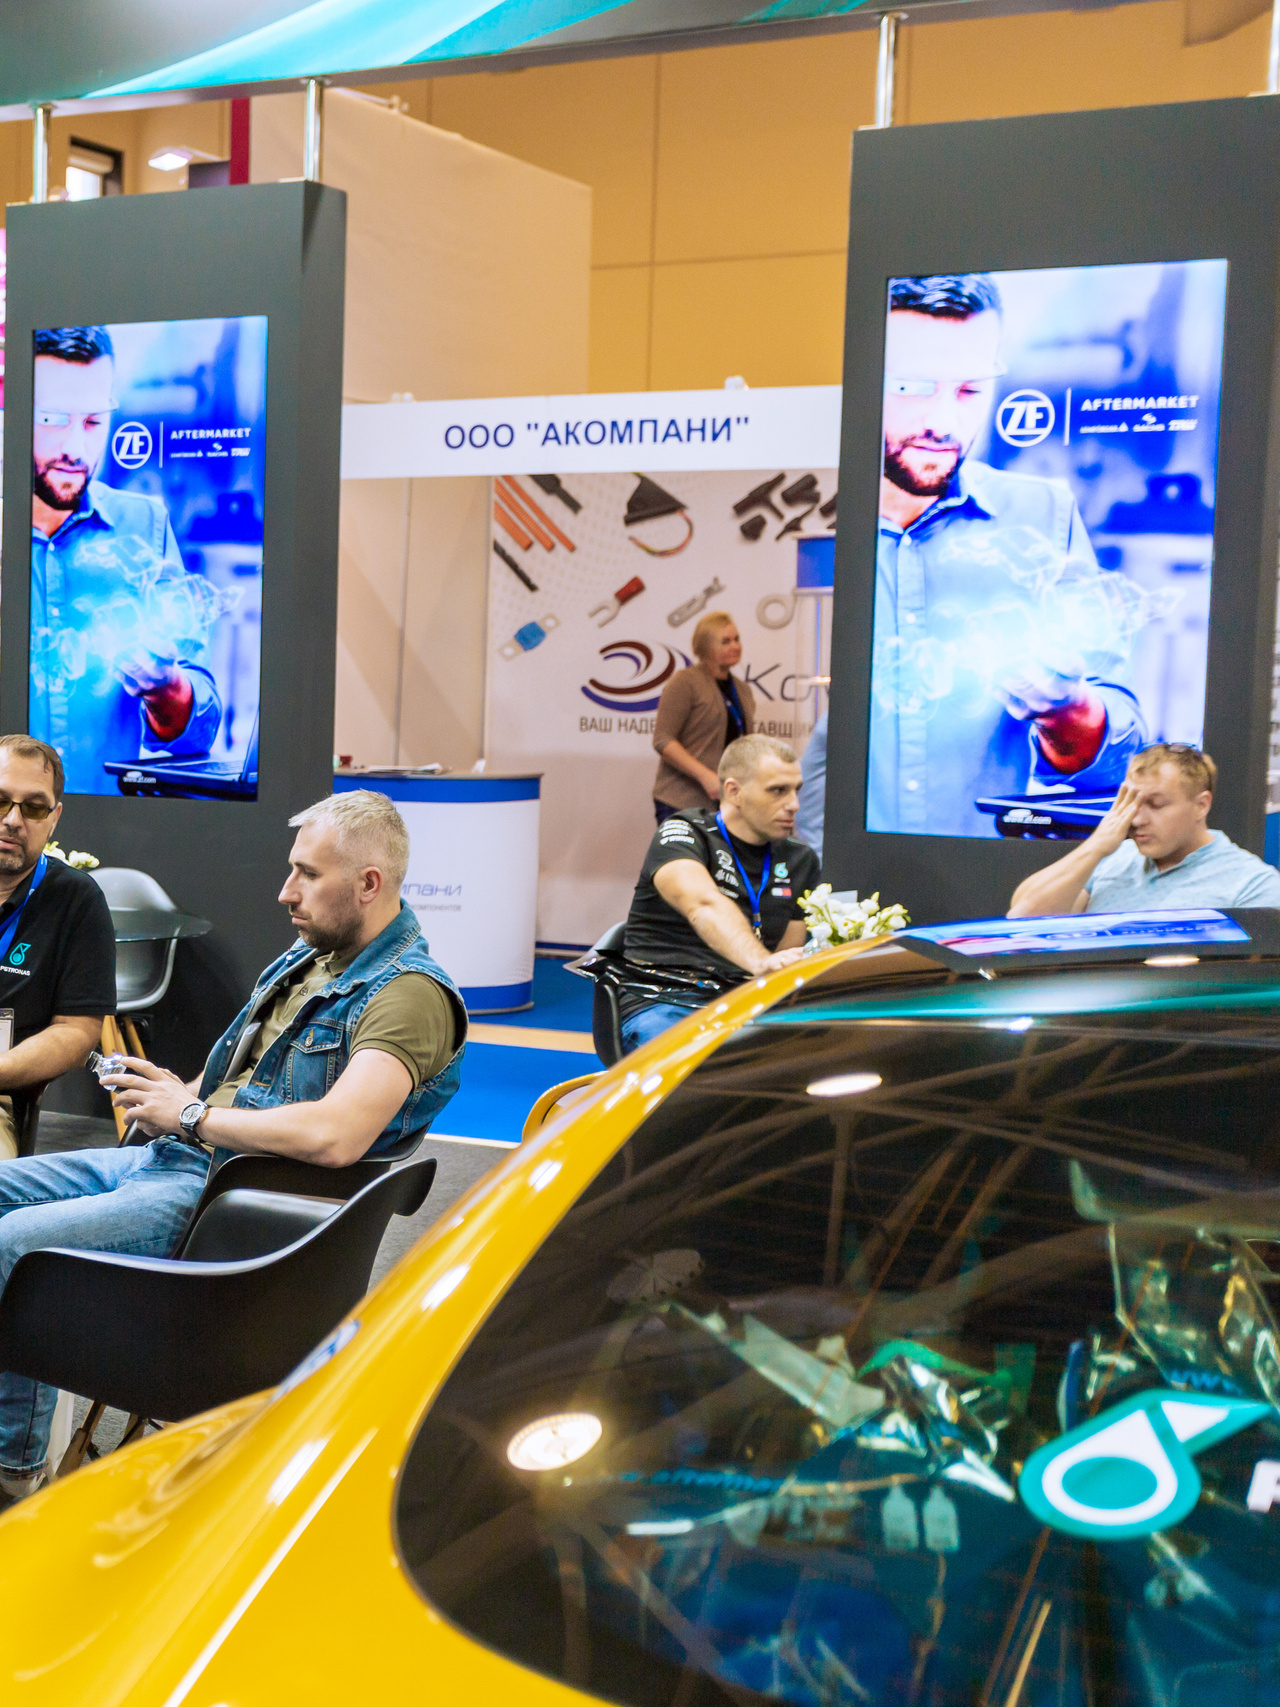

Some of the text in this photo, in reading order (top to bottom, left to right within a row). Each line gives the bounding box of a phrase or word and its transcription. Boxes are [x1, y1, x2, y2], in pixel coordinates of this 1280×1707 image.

[1080, 395, 1200, 412] AFTERMARKET
[1001, 397, 1051, 439] ZF
[170, 427, 252, 441] AFTERMARKET
[444, 416, 749, 449] ООО "АКОМПАНИ"
[115, 429, 150, 462] ZF
[579, 716, 613, 734] ВАШ
[0, 965, 31, 977] PETRONAS
